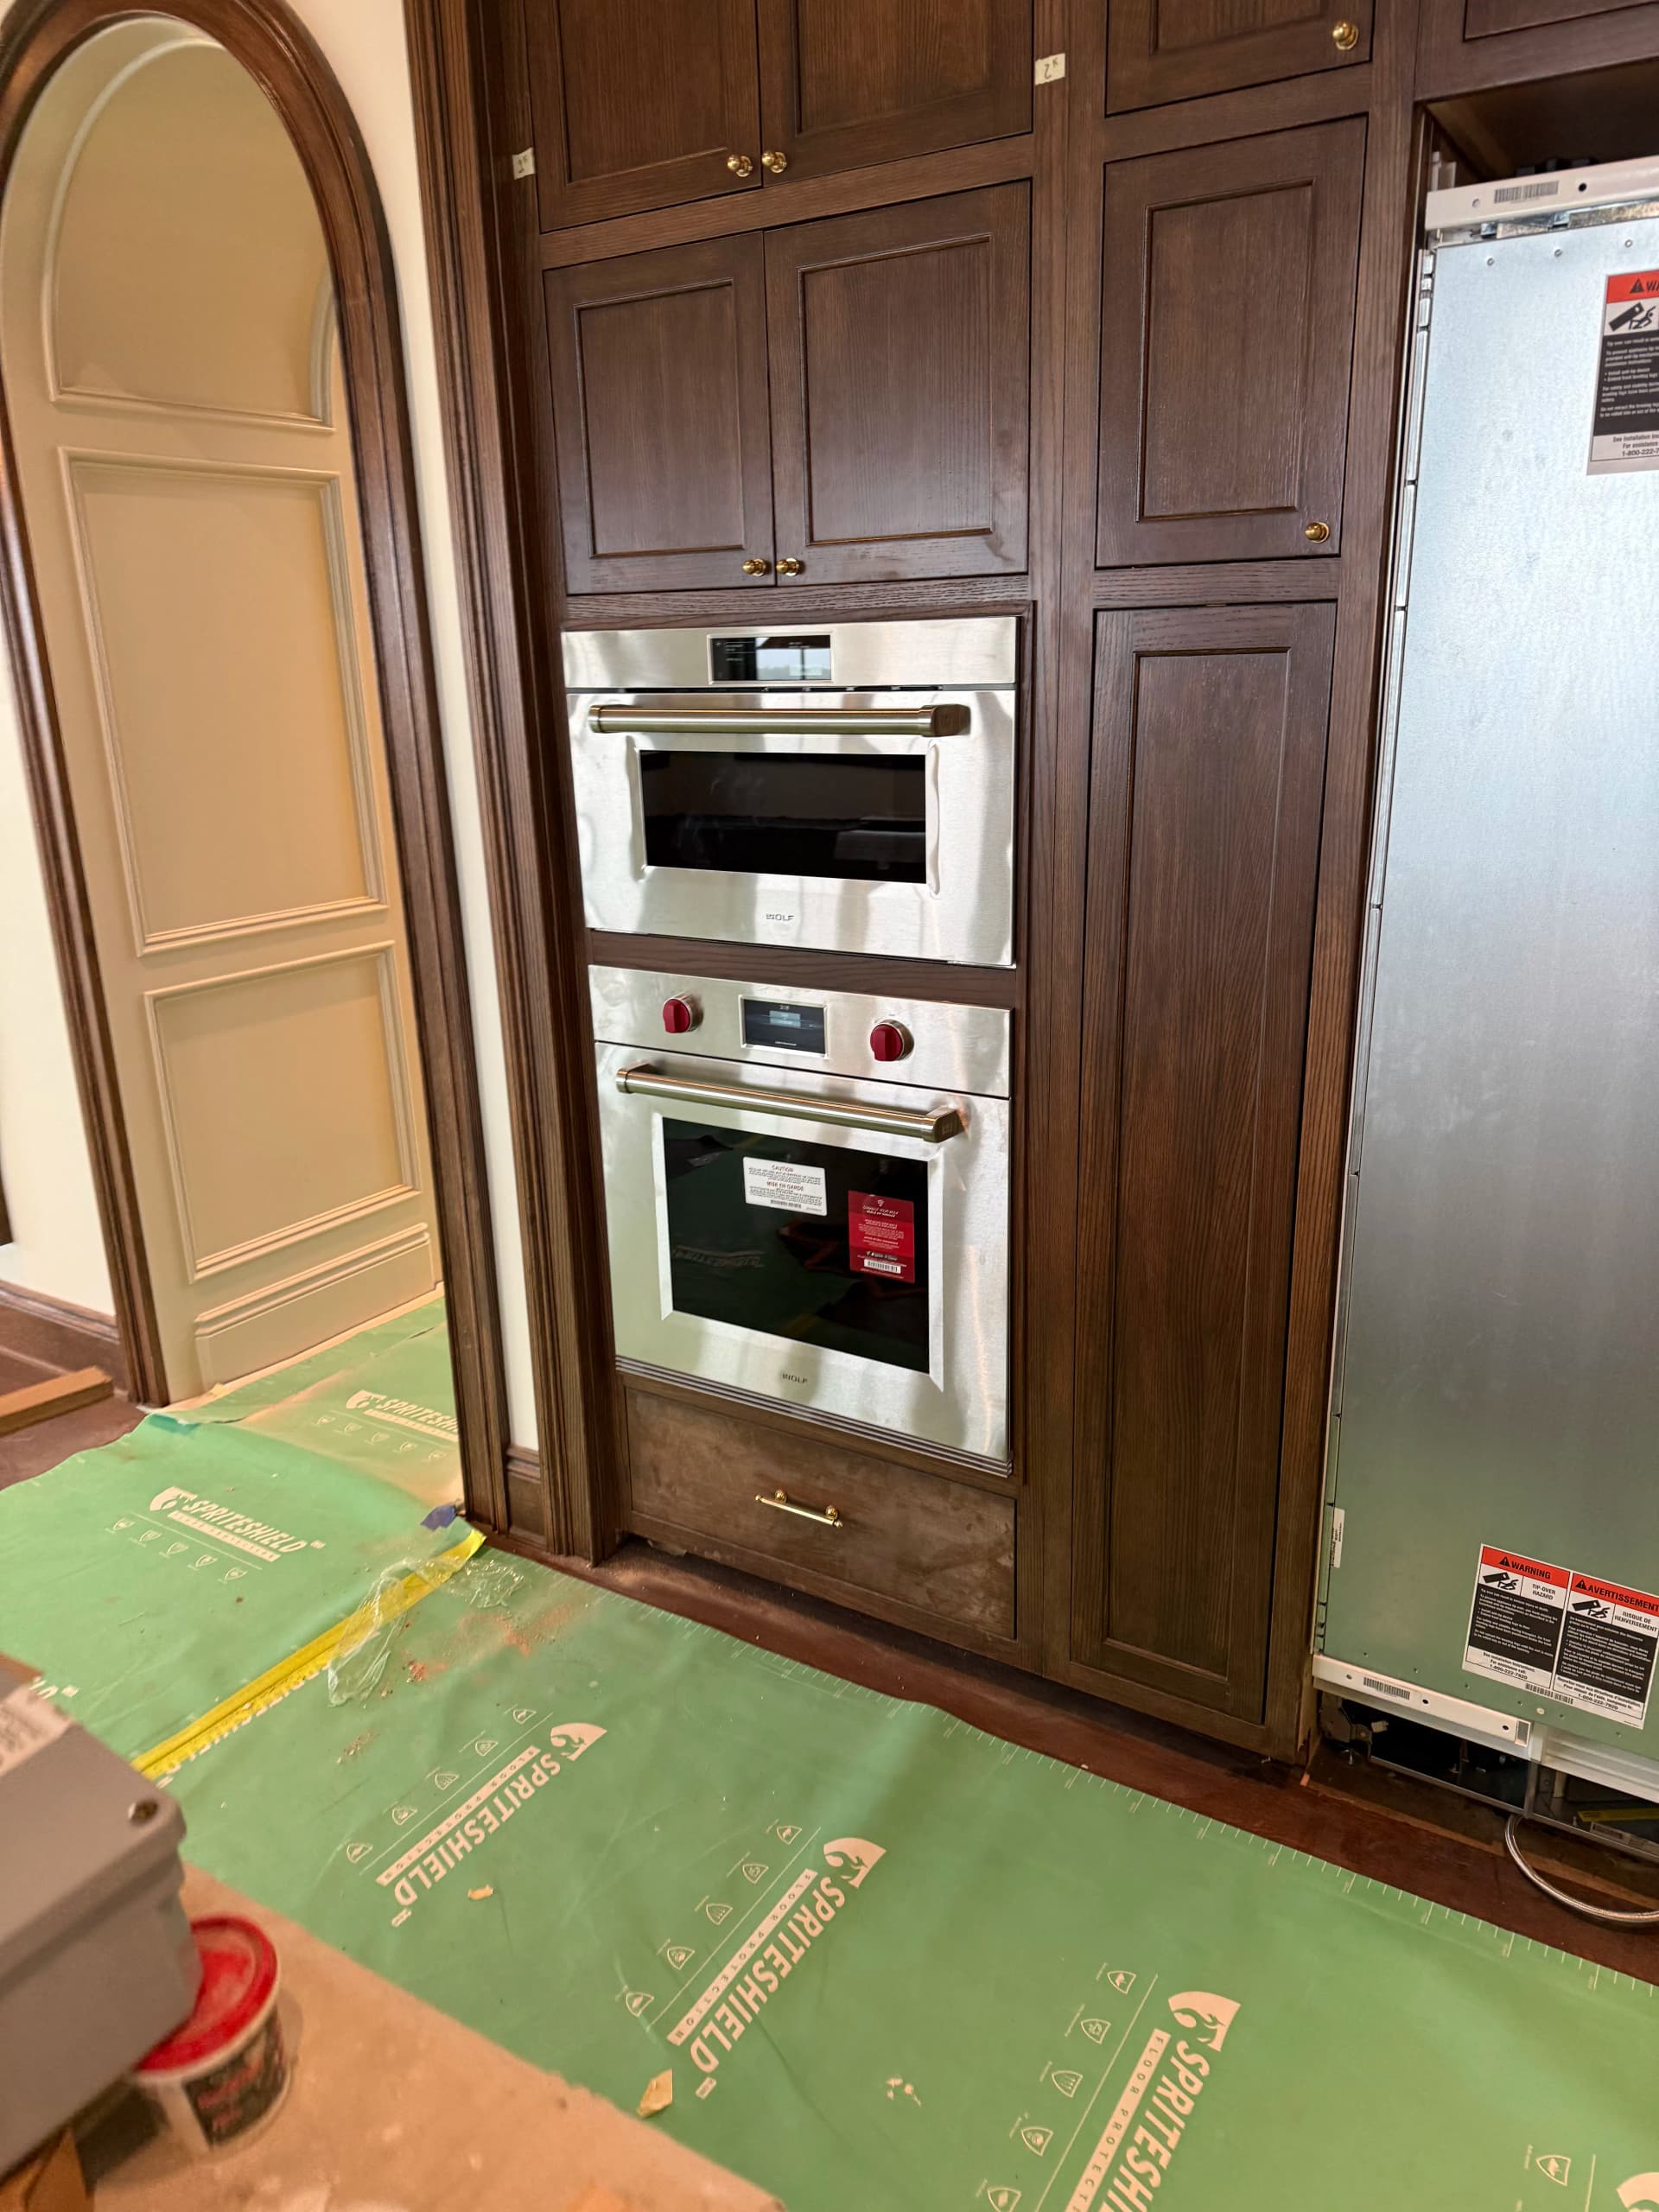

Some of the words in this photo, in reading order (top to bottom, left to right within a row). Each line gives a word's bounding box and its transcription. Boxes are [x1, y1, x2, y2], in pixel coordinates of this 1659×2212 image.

[181, 1500, 308, 1554] SPRITESHIELD
[1511, 1561, 1551, 1580] WARNING
[1532, 1583, 1555, 1595] TIP-OVER
[1588, 1585, 1659, 1612] AVERTISSEMENT
[394, 1753, 560, 1907] SPRITESHIELD
[769, 1872, 810, 1922] FLOOR
[674, 1928, 764, 2040] PROTECTION
[690, 1877, 845, 2073] SPRITESHIELD
[1130, 2037, 1165, 2094] FLOOR
[1099, 2040, 1210, 2212] SPRITESHI
